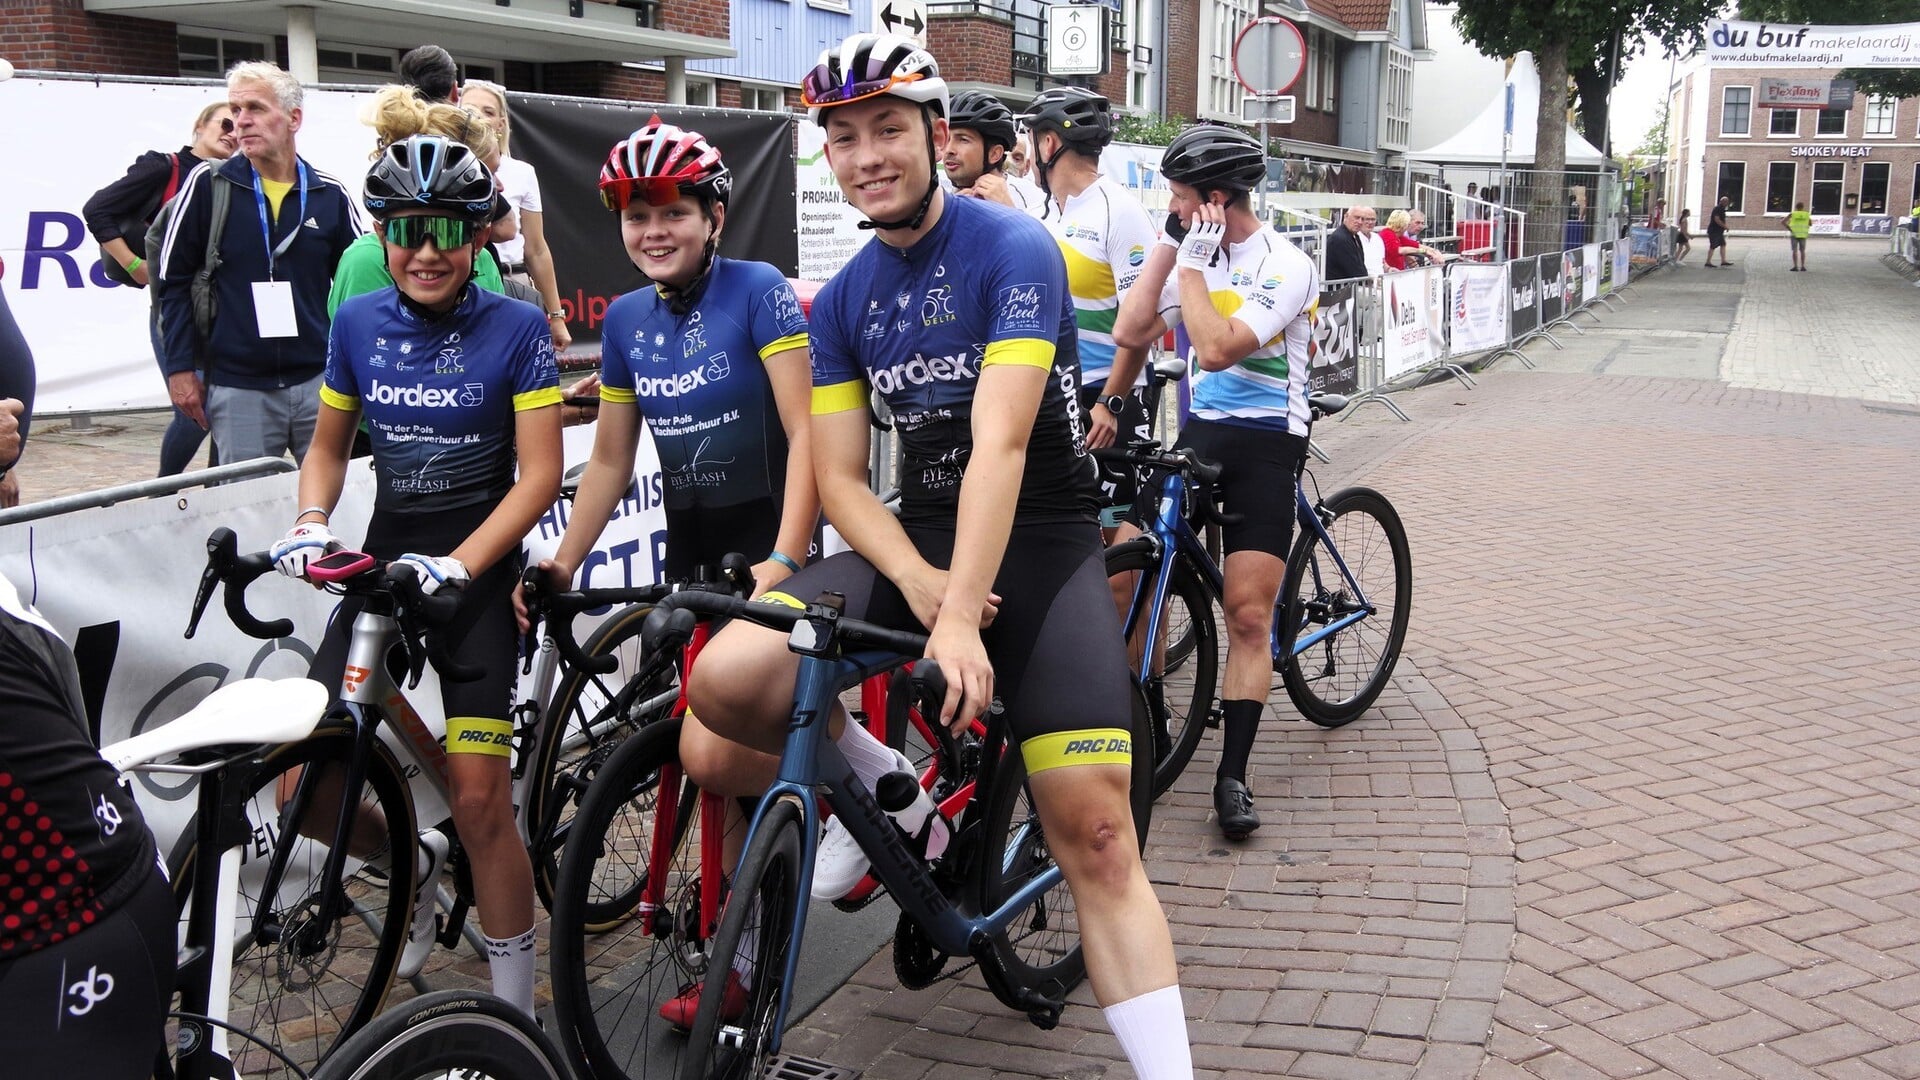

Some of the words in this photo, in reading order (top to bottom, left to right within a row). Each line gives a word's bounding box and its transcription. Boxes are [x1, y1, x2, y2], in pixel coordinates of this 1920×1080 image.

[1070, 33, 1079, 45] 6
[1713, 24, 1748, 47] du
[1756, 25, 1810, 48] buf
[1809, 35, 1912, 52] makelaardij
[1711, 52, 1843, 64] www.dubufmakelaardij.nl
[1871, 55, 1891, 63] Thuis
[1790, 146, 1838, 157] SMOKEY
[1840, 146, 1872, 157] MEAT
[802, 190, 840, 204] PROPAAN
[1006, 287, 1041, 306] Liefs
[1000, 306, 1007, 316] &
[1007, 304, 1039, 320] Leed
[924, 313, 957, 327] DELTA
[684, 342, 707, 358] DELTA
[435, 366, 465, 374] DELTA
[365, 379, 459, 408] Jordex
[657, 416, 671, 426] der
[673, 414, 693, 425] Pols
[723, 409, 740, 424] B.V.
[378, 422, 393, 432] van
[394, 424, 411, 433] der
[413, 425, 434, 434] Pols
[464, 433, 481, 443] B.V.
[457, 729, 494, 743] PRC
[1063, 738, 1106, 755] PRC
[406, 1000, 480, 1027] CONTINENTAL
